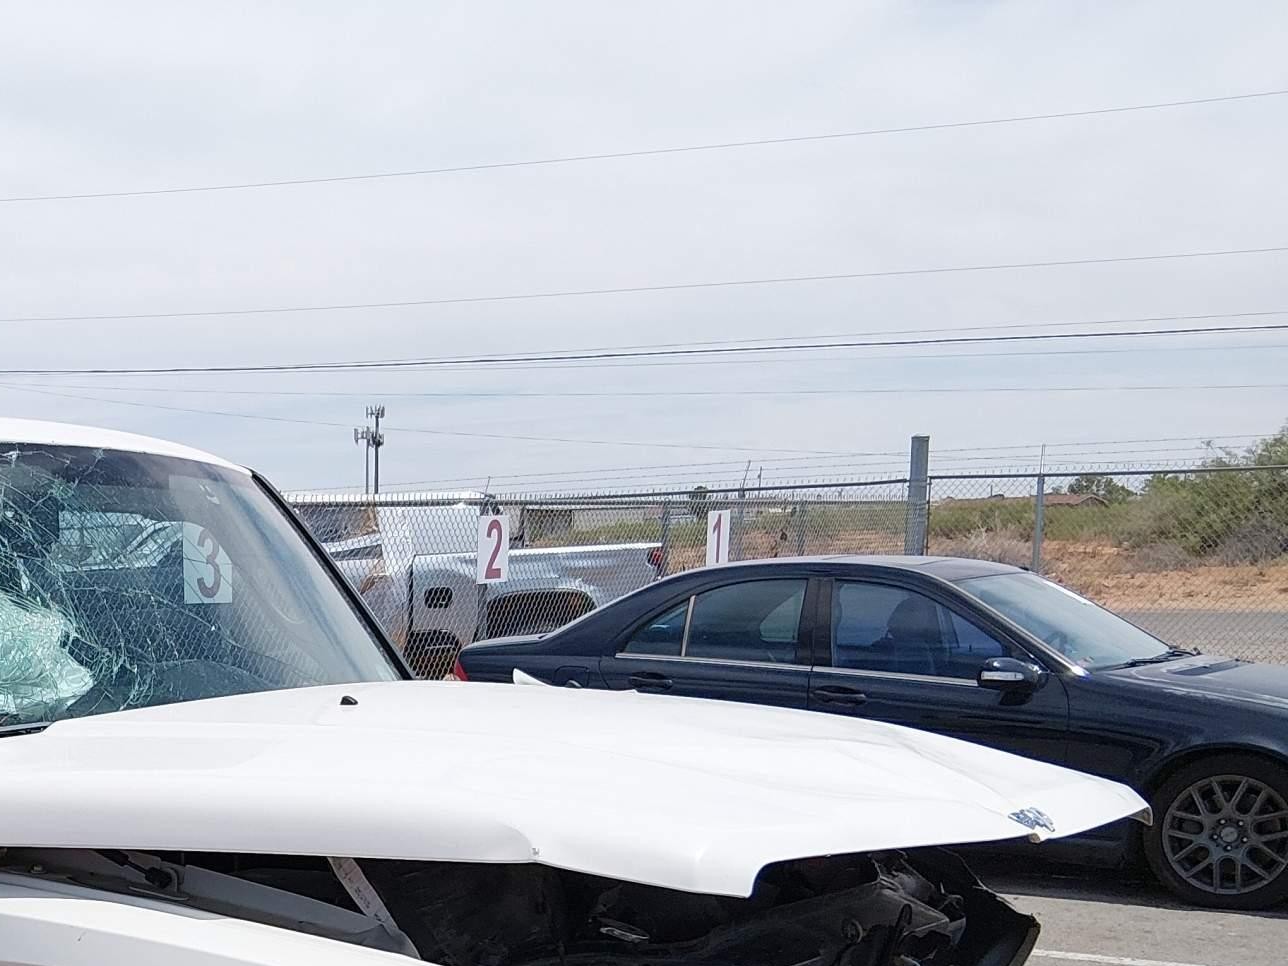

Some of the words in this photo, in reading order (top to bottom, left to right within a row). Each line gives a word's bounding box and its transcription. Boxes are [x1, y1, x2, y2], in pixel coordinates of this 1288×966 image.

[196, 527, 222, 599] 3
[484, 518, 503, 580] 2
[712, 512, 722, 564] 1
